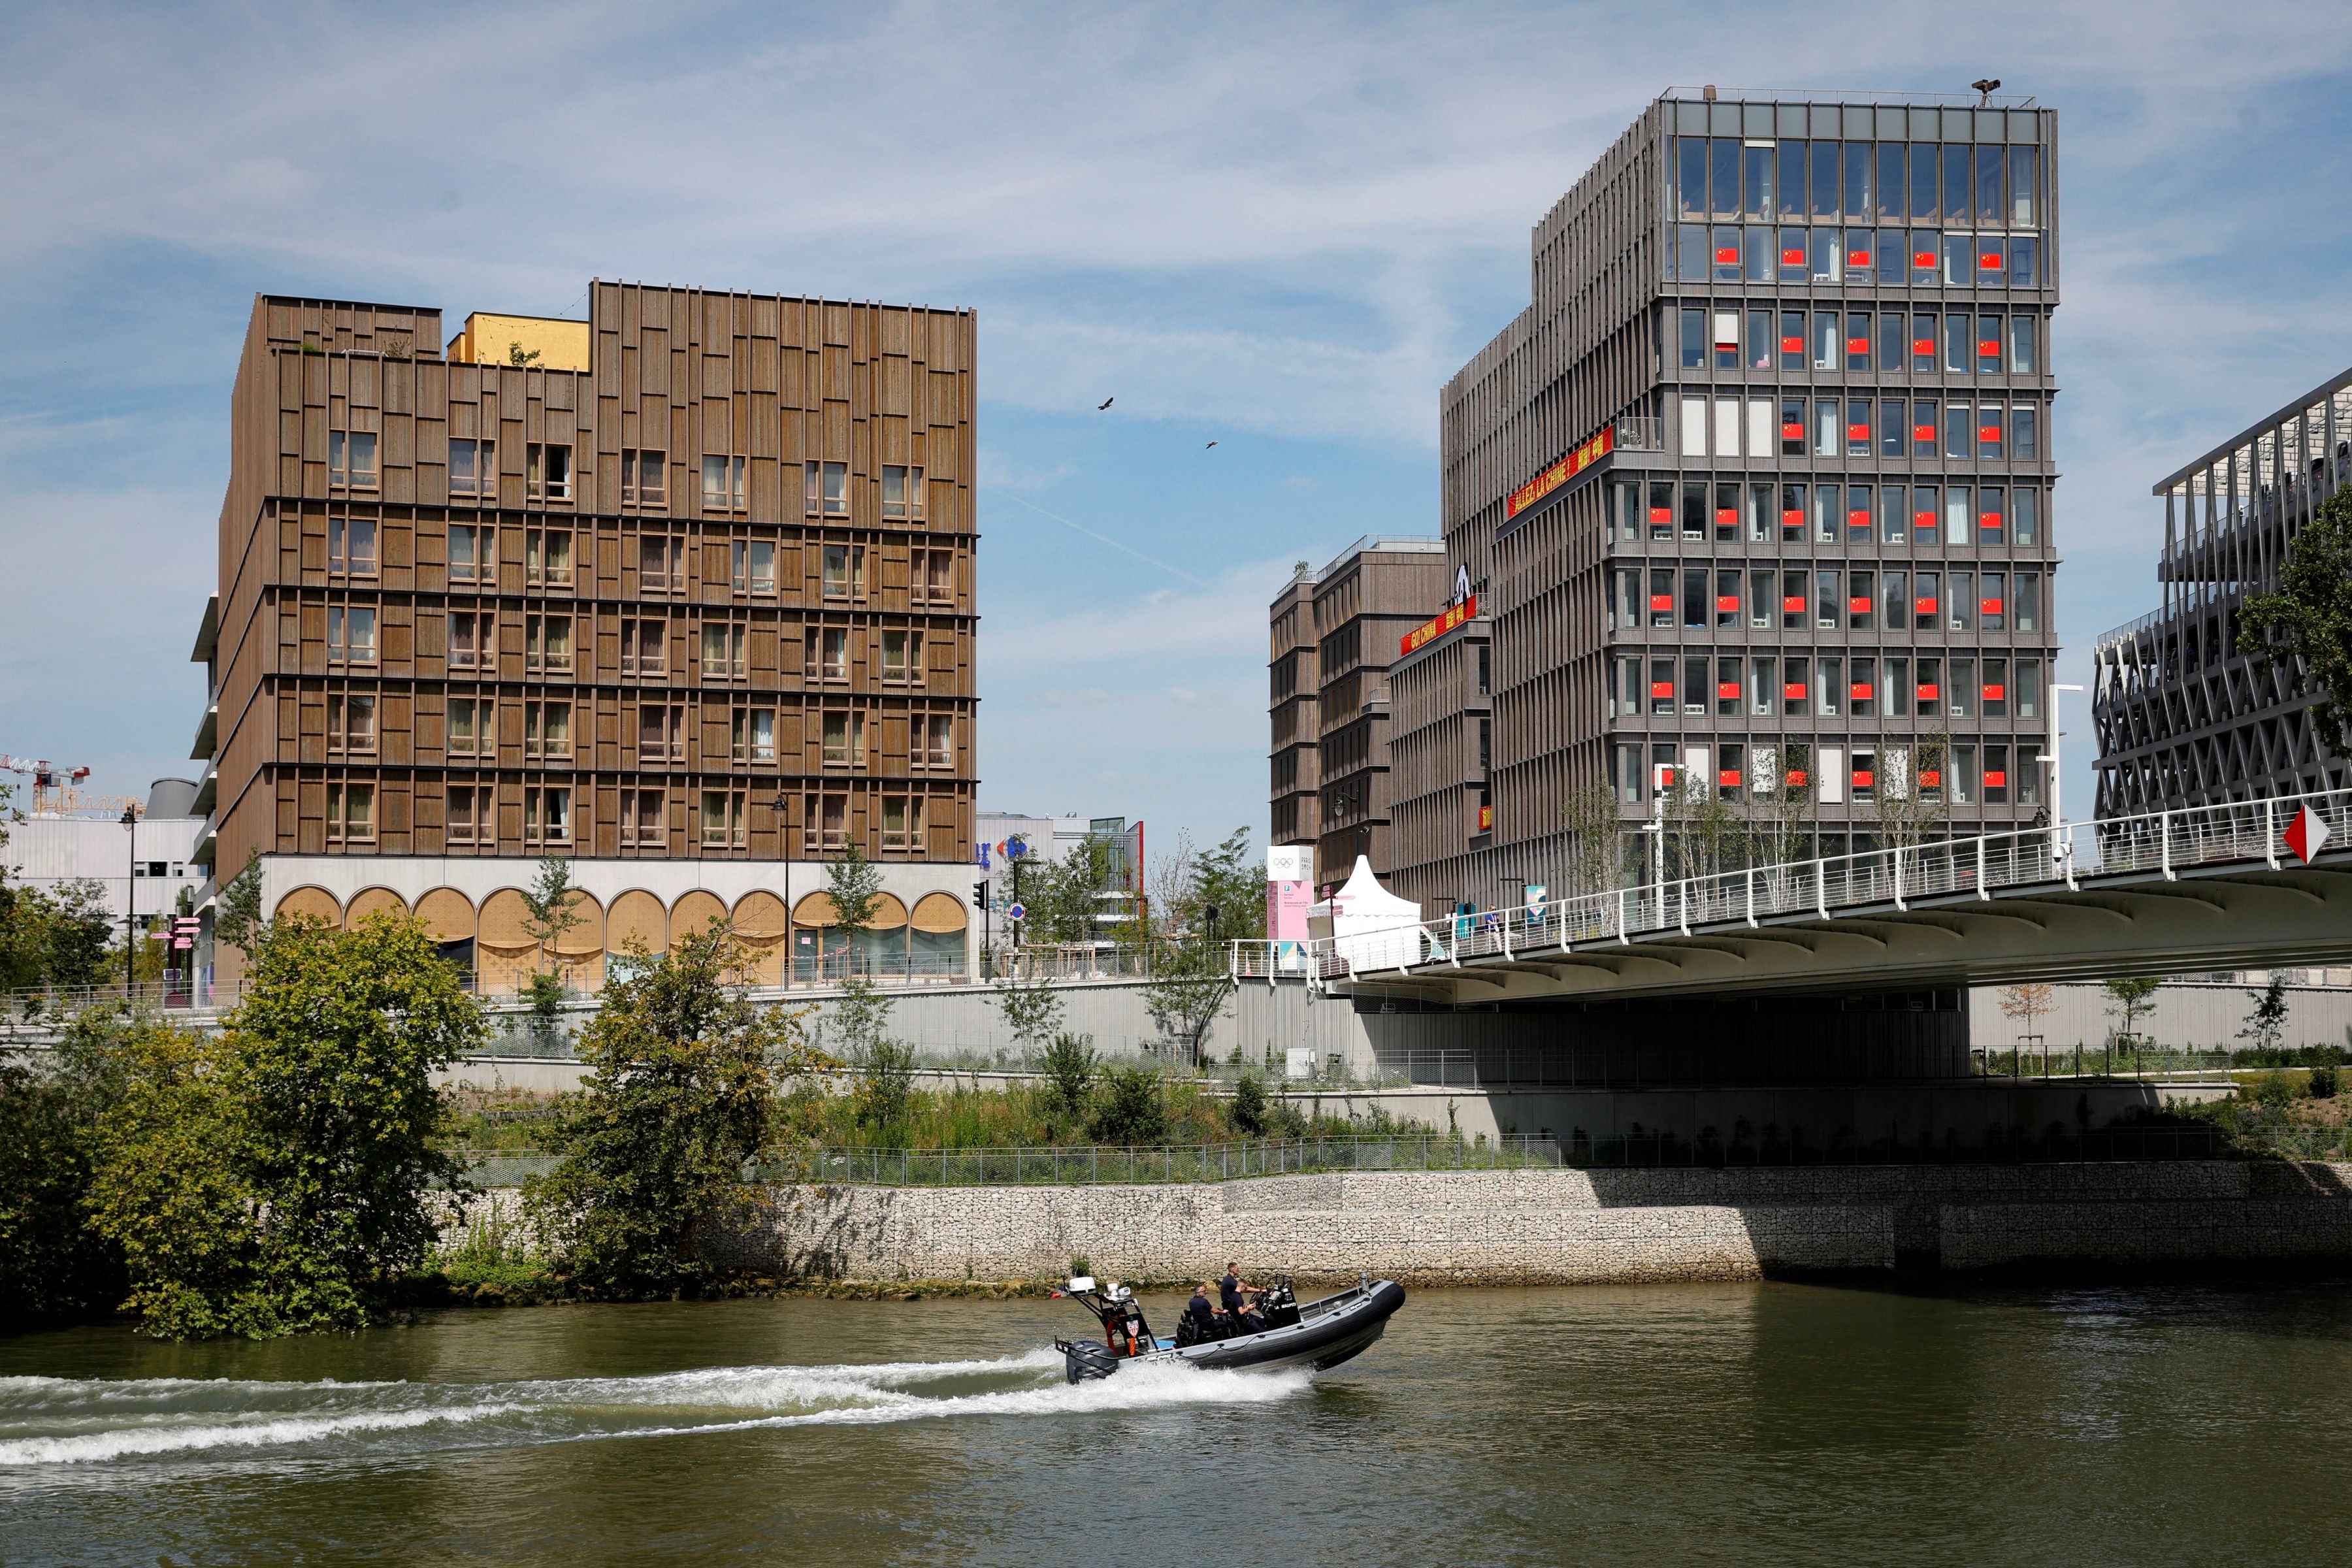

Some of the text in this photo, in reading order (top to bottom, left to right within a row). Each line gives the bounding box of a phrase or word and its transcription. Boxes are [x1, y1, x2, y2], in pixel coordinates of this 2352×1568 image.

[1536, 478, 1544, 498] LA
[1411, 620, 1436, 649] GO! CHINA
